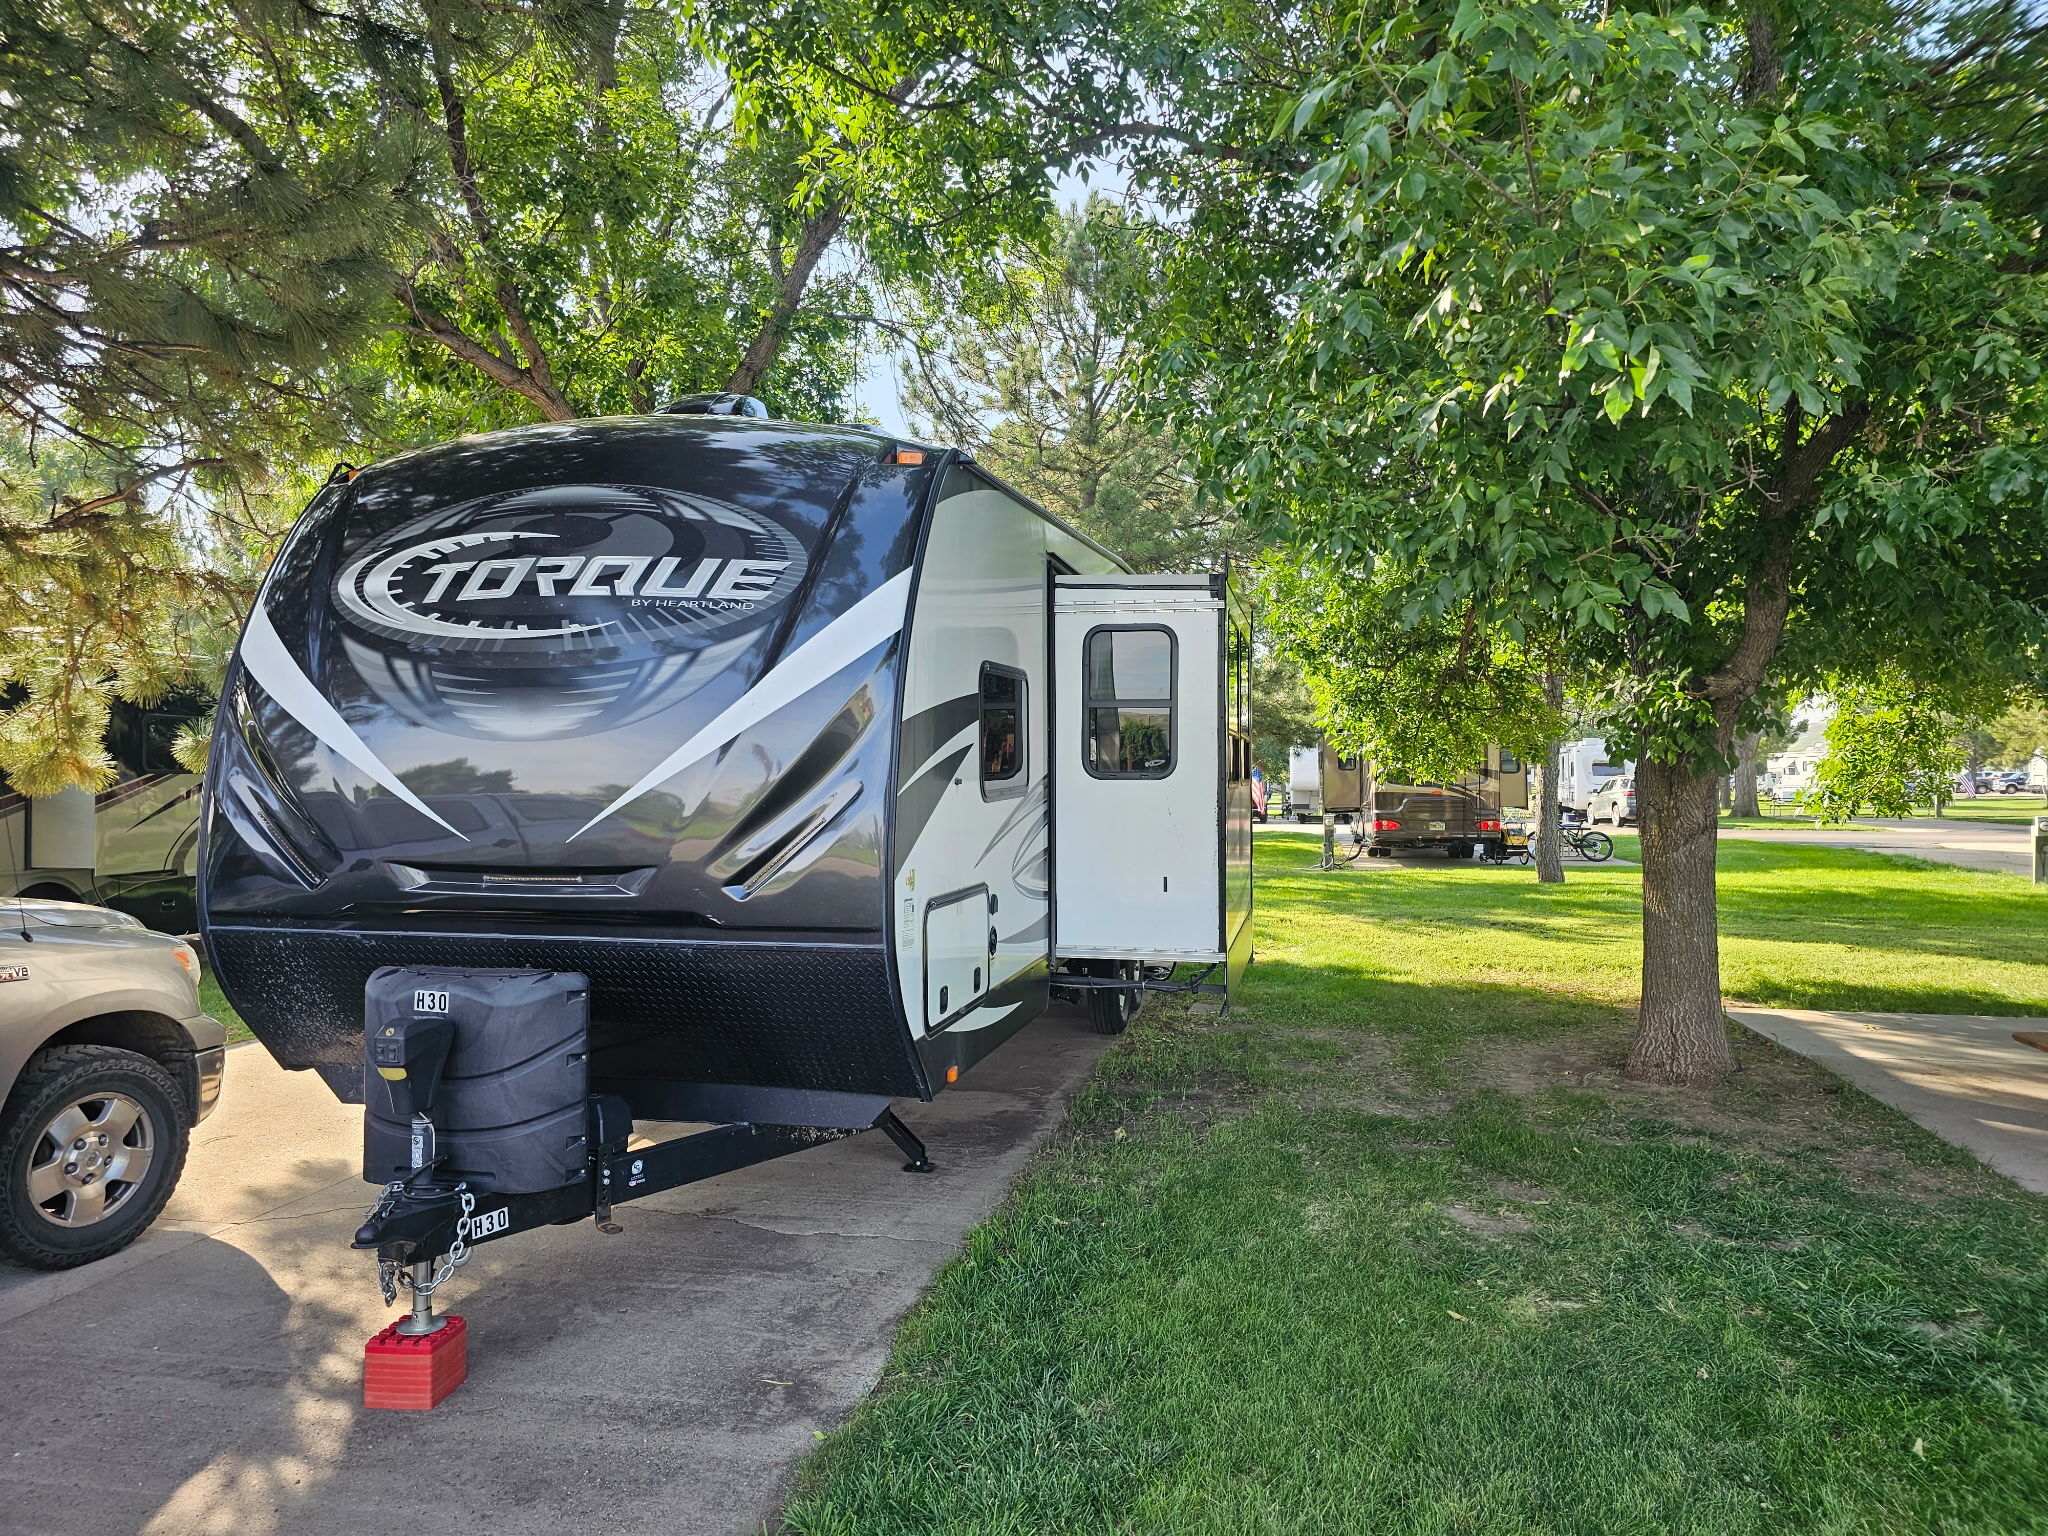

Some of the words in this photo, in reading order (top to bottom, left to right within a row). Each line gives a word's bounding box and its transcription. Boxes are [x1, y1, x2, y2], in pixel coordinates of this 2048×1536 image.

[422, 555, 793, 603] TORQUE
[631, 599, 651, 607] BY
[655, 599, 755, 610] HEARTLAND
[416, 991, 447, 1011] H30
[473, 1210, 506, 1237] H30
